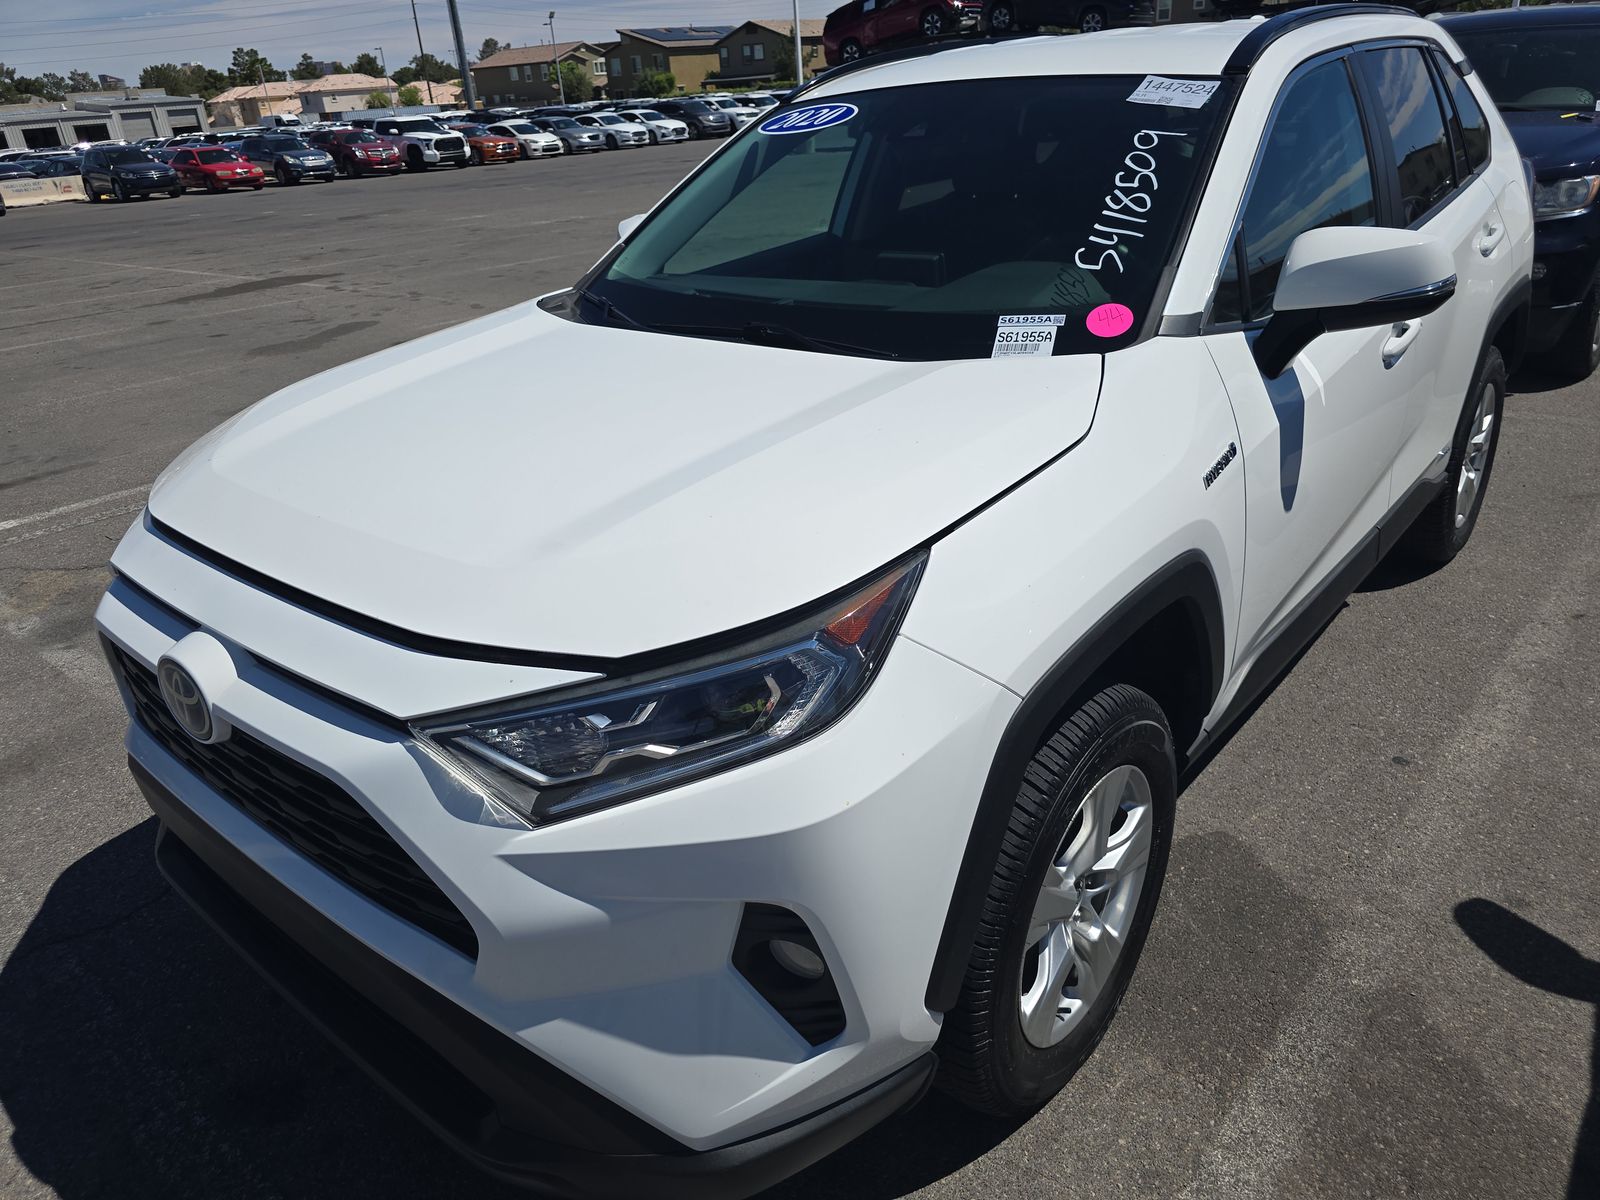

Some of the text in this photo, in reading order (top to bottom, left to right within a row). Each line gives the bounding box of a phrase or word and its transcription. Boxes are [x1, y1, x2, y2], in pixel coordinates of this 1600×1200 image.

[1143, 79, 1217, 96] 1447524
[765, 106, 848, 131] 2020
[1074, 129, 1188, 274] 5418509
[999, 315, 1053, 325] S61955A
[1096, 304, 1124, 328] 44
[997, 331, 1053, 343] S61955A
